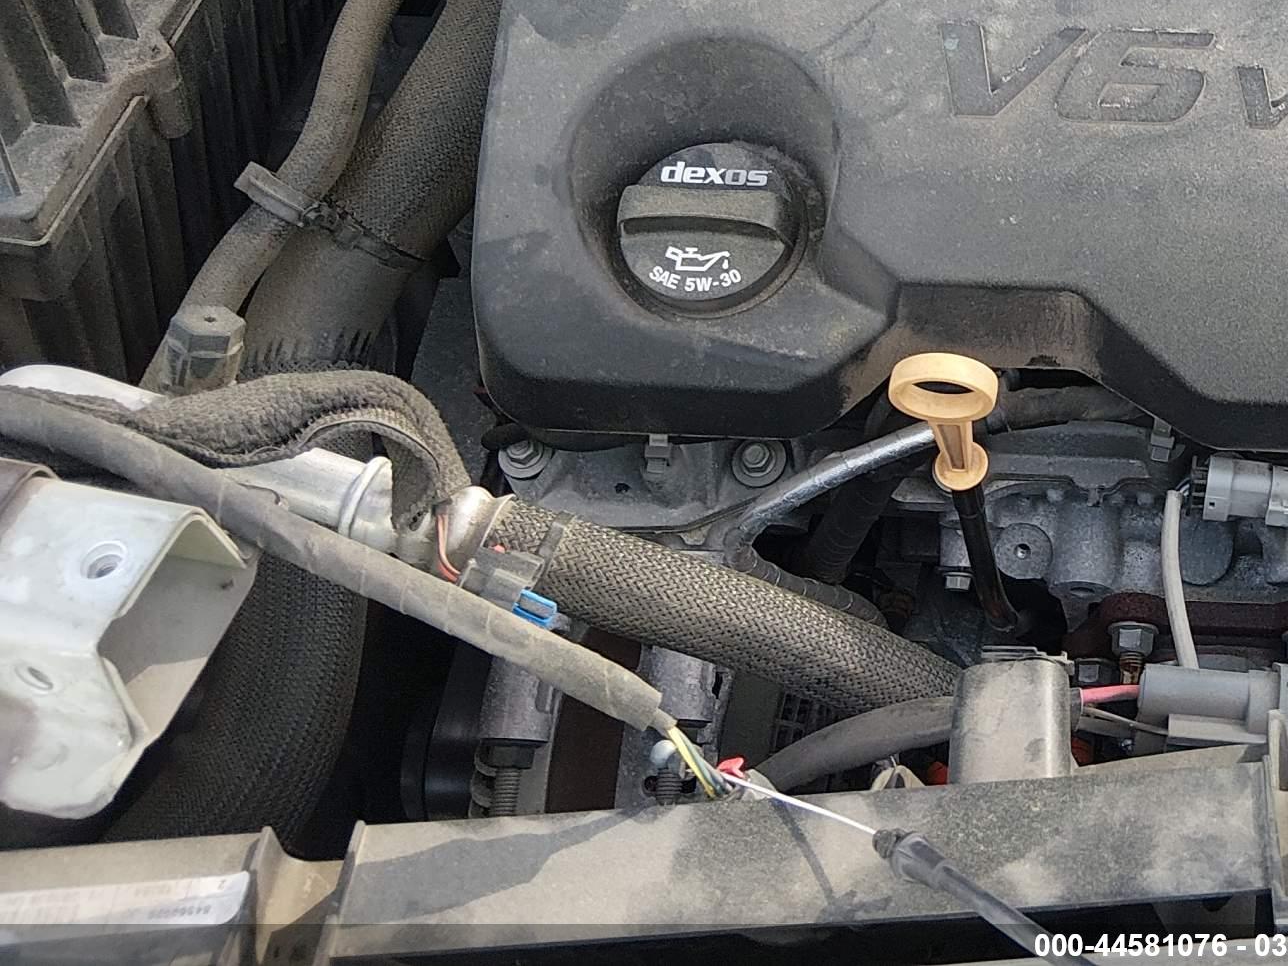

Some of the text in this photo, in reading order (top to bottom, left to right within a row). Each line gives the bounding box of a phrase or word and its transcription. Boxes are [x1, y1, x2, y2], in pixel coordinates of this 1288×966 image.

[938, 22, 1217, 124] V6
[660, 161, 769, 187] dexos
[648, 265, 742, 292] SAE 5W-30
